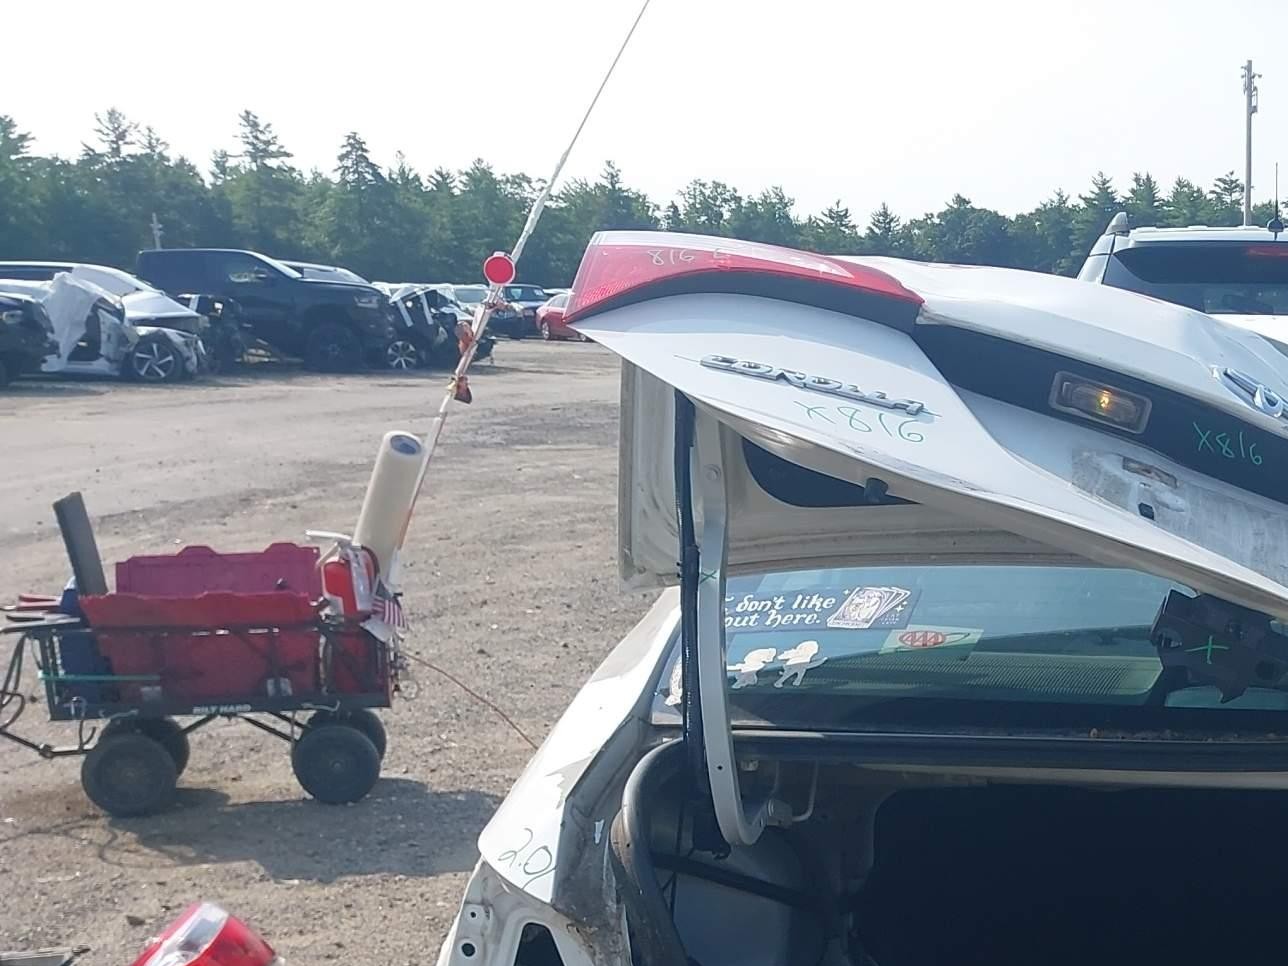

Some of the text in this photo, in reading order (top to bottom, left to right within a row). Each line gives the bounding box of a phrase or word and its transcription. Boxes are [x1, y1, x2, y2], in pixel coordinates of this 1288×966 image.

[648, 248, 695, 266] 816
[700, 354, 925, 416] COROLLA
[793, 400, 925, 444] X816
[1192, 421, 1263, 466] X816
[736, 595, 785, 612] don't
[792, 594, 836, 611] like
[764, 609, 821, 627] here.
